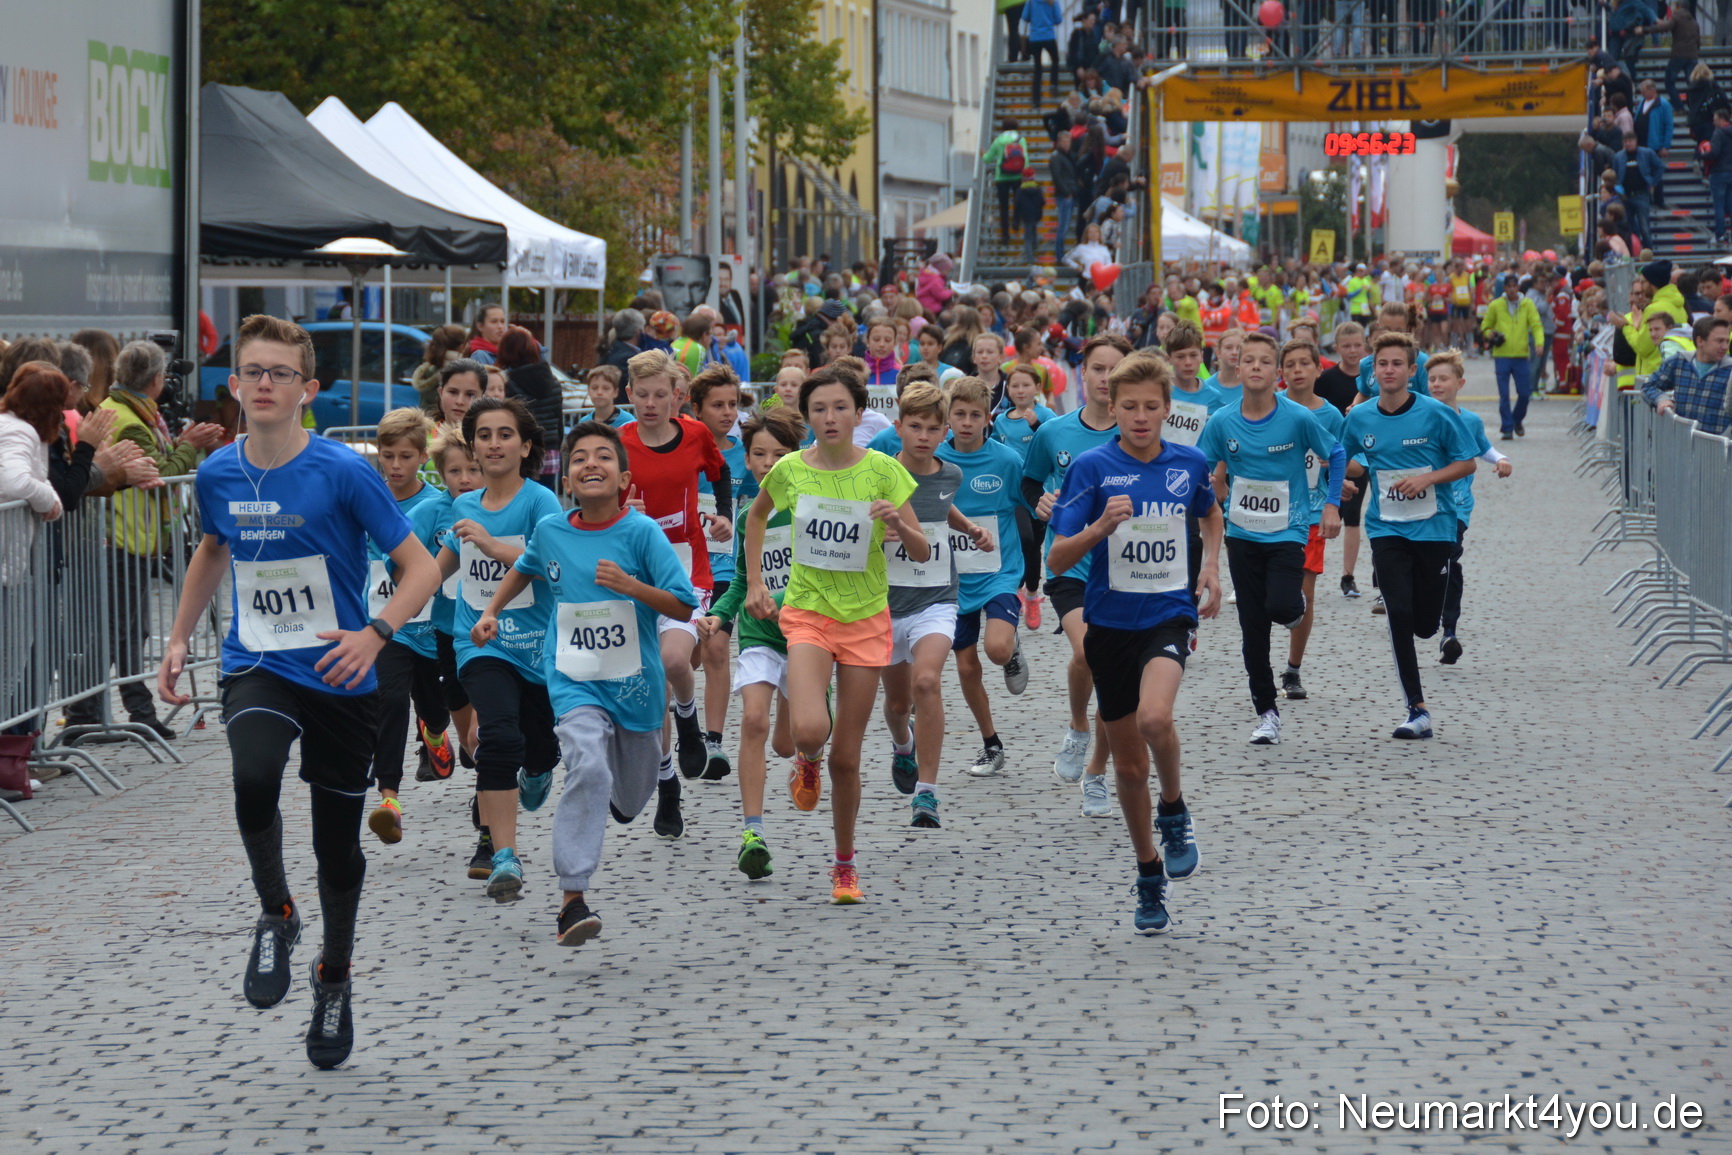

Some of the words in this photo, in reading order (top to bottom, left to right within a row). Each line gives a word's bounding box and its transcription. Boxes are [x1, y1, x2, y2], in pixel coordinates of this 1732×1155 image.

[13, 67, 58, 128] LOUNGE
[1327, 79, 1421, 111] ZIEL
[89, 56, 168, 173] BOCK
[1499, 221, 1509, 235] B
[1315, 240, 1328, 256] A
[866, 397, 894, 409] 4019
[1167, 414, 1199, 432] 4046
[1268, 442, 1295, 452] BOCK
[1403, 437, 1428, 445] BOCK
[973, 479, 1000, 489] Hervis
[239, 503, 271, 512] HEUTE
[1239, 495, 1280, 513] 4040
[249, 516, 296, 525] MORGEN
[240, 530, 286, 540] BEWEGEN
[805, 518, 859, 544] 4004
[950, 535, 979, 552] 403
[811, 546, 827, 556] Luca
[829, 550, 851, 560] Ronja
[1121, 539, 1176, 563] 4005
[265, 567, 298, 579] BOCK
[1130, 571, 1170, 580] Alexander
[253, 585, 315, 615] 4011
[273, 623, 304, 634] Tobias
[498, 617, 520, 633] 18.
[501, 639, 537, 649] Stadtlauf
[570, 624, 626, 651] 4033
